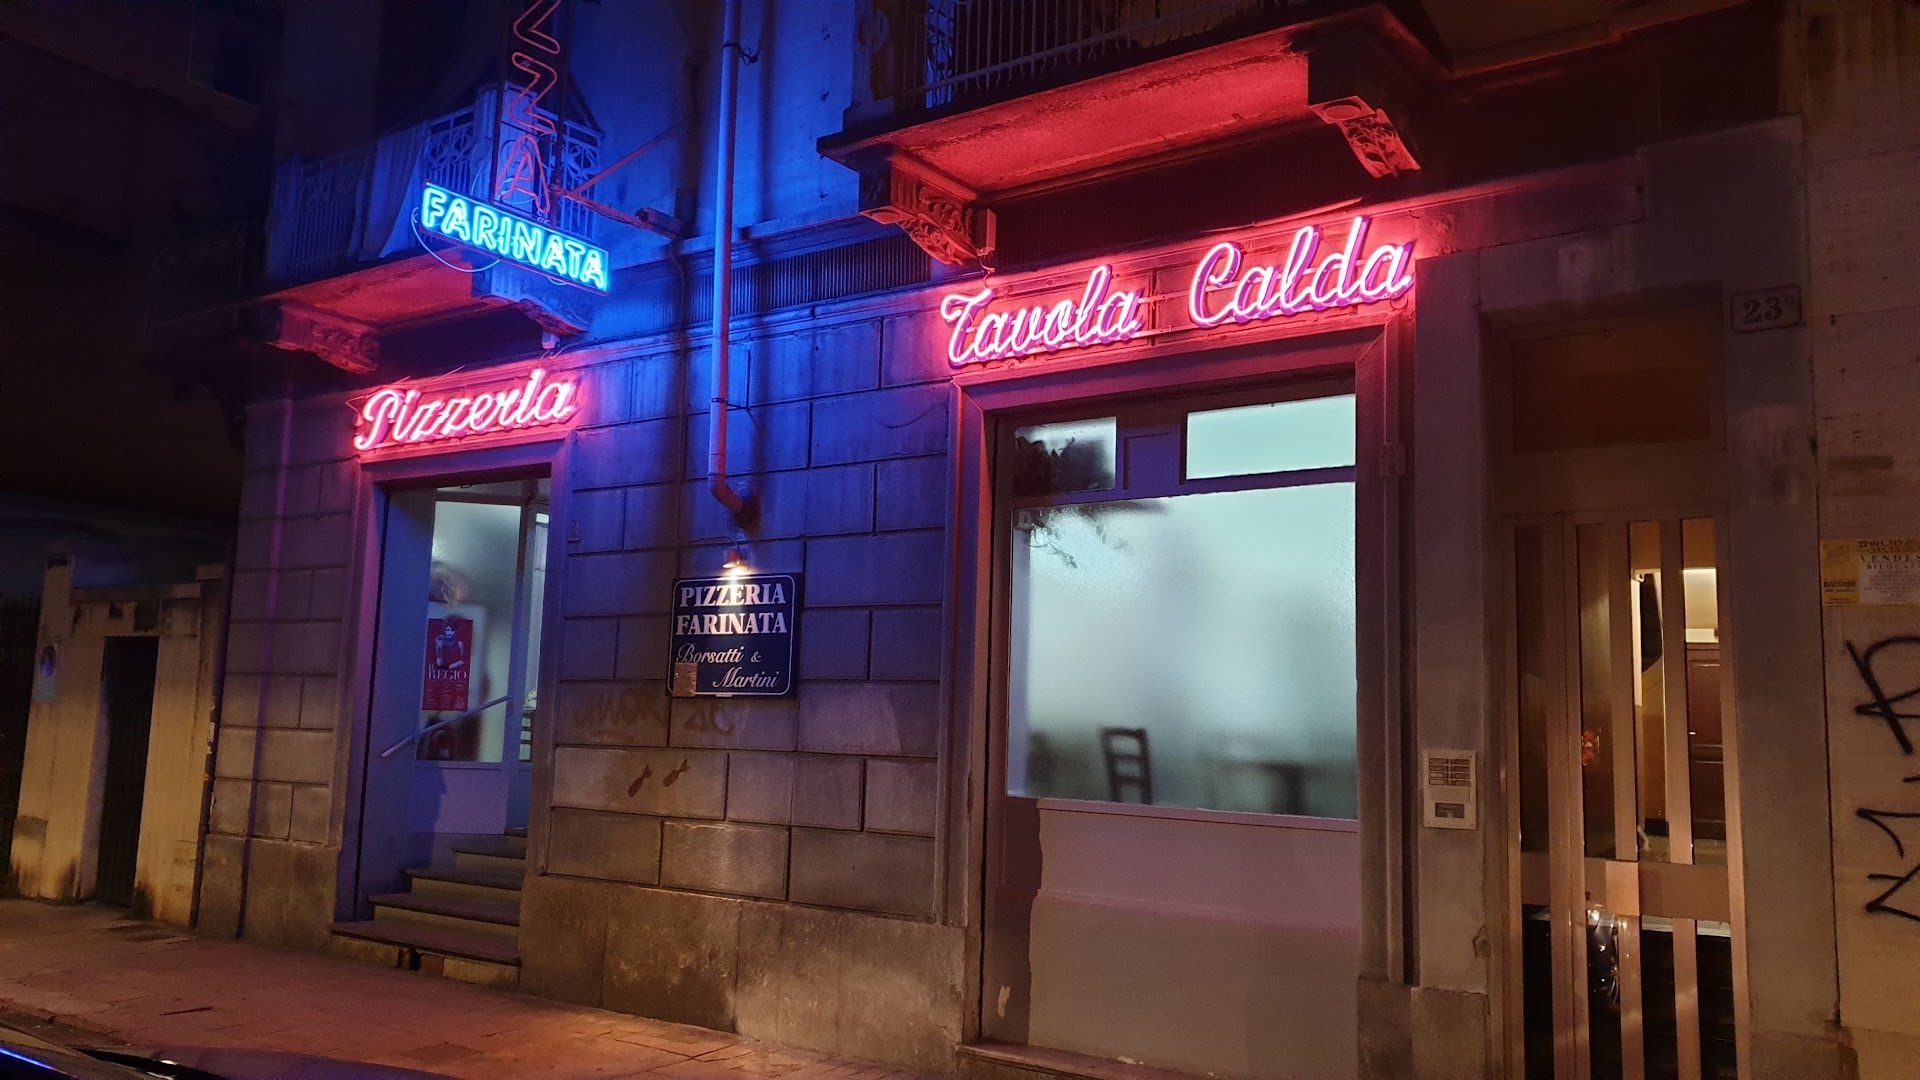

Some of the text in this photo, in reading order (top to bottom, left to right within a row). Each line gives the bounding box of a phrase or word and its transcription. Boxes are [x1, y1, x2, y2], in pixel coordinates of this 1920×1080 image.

[421, 187, 606, 289] FARINATA
[940, 215, 1416, 367] Tavola Calda
[354, 369, 578, 449] Pizzeria
[679, 583, 787, 607] PIZZERIA
[675, 612, 788, 635] FARINATA
[676, 643, 763, 663] Borsatti &
[428, 669, 467, 680] REGIO
[712, 667, 780, 688] Martini
